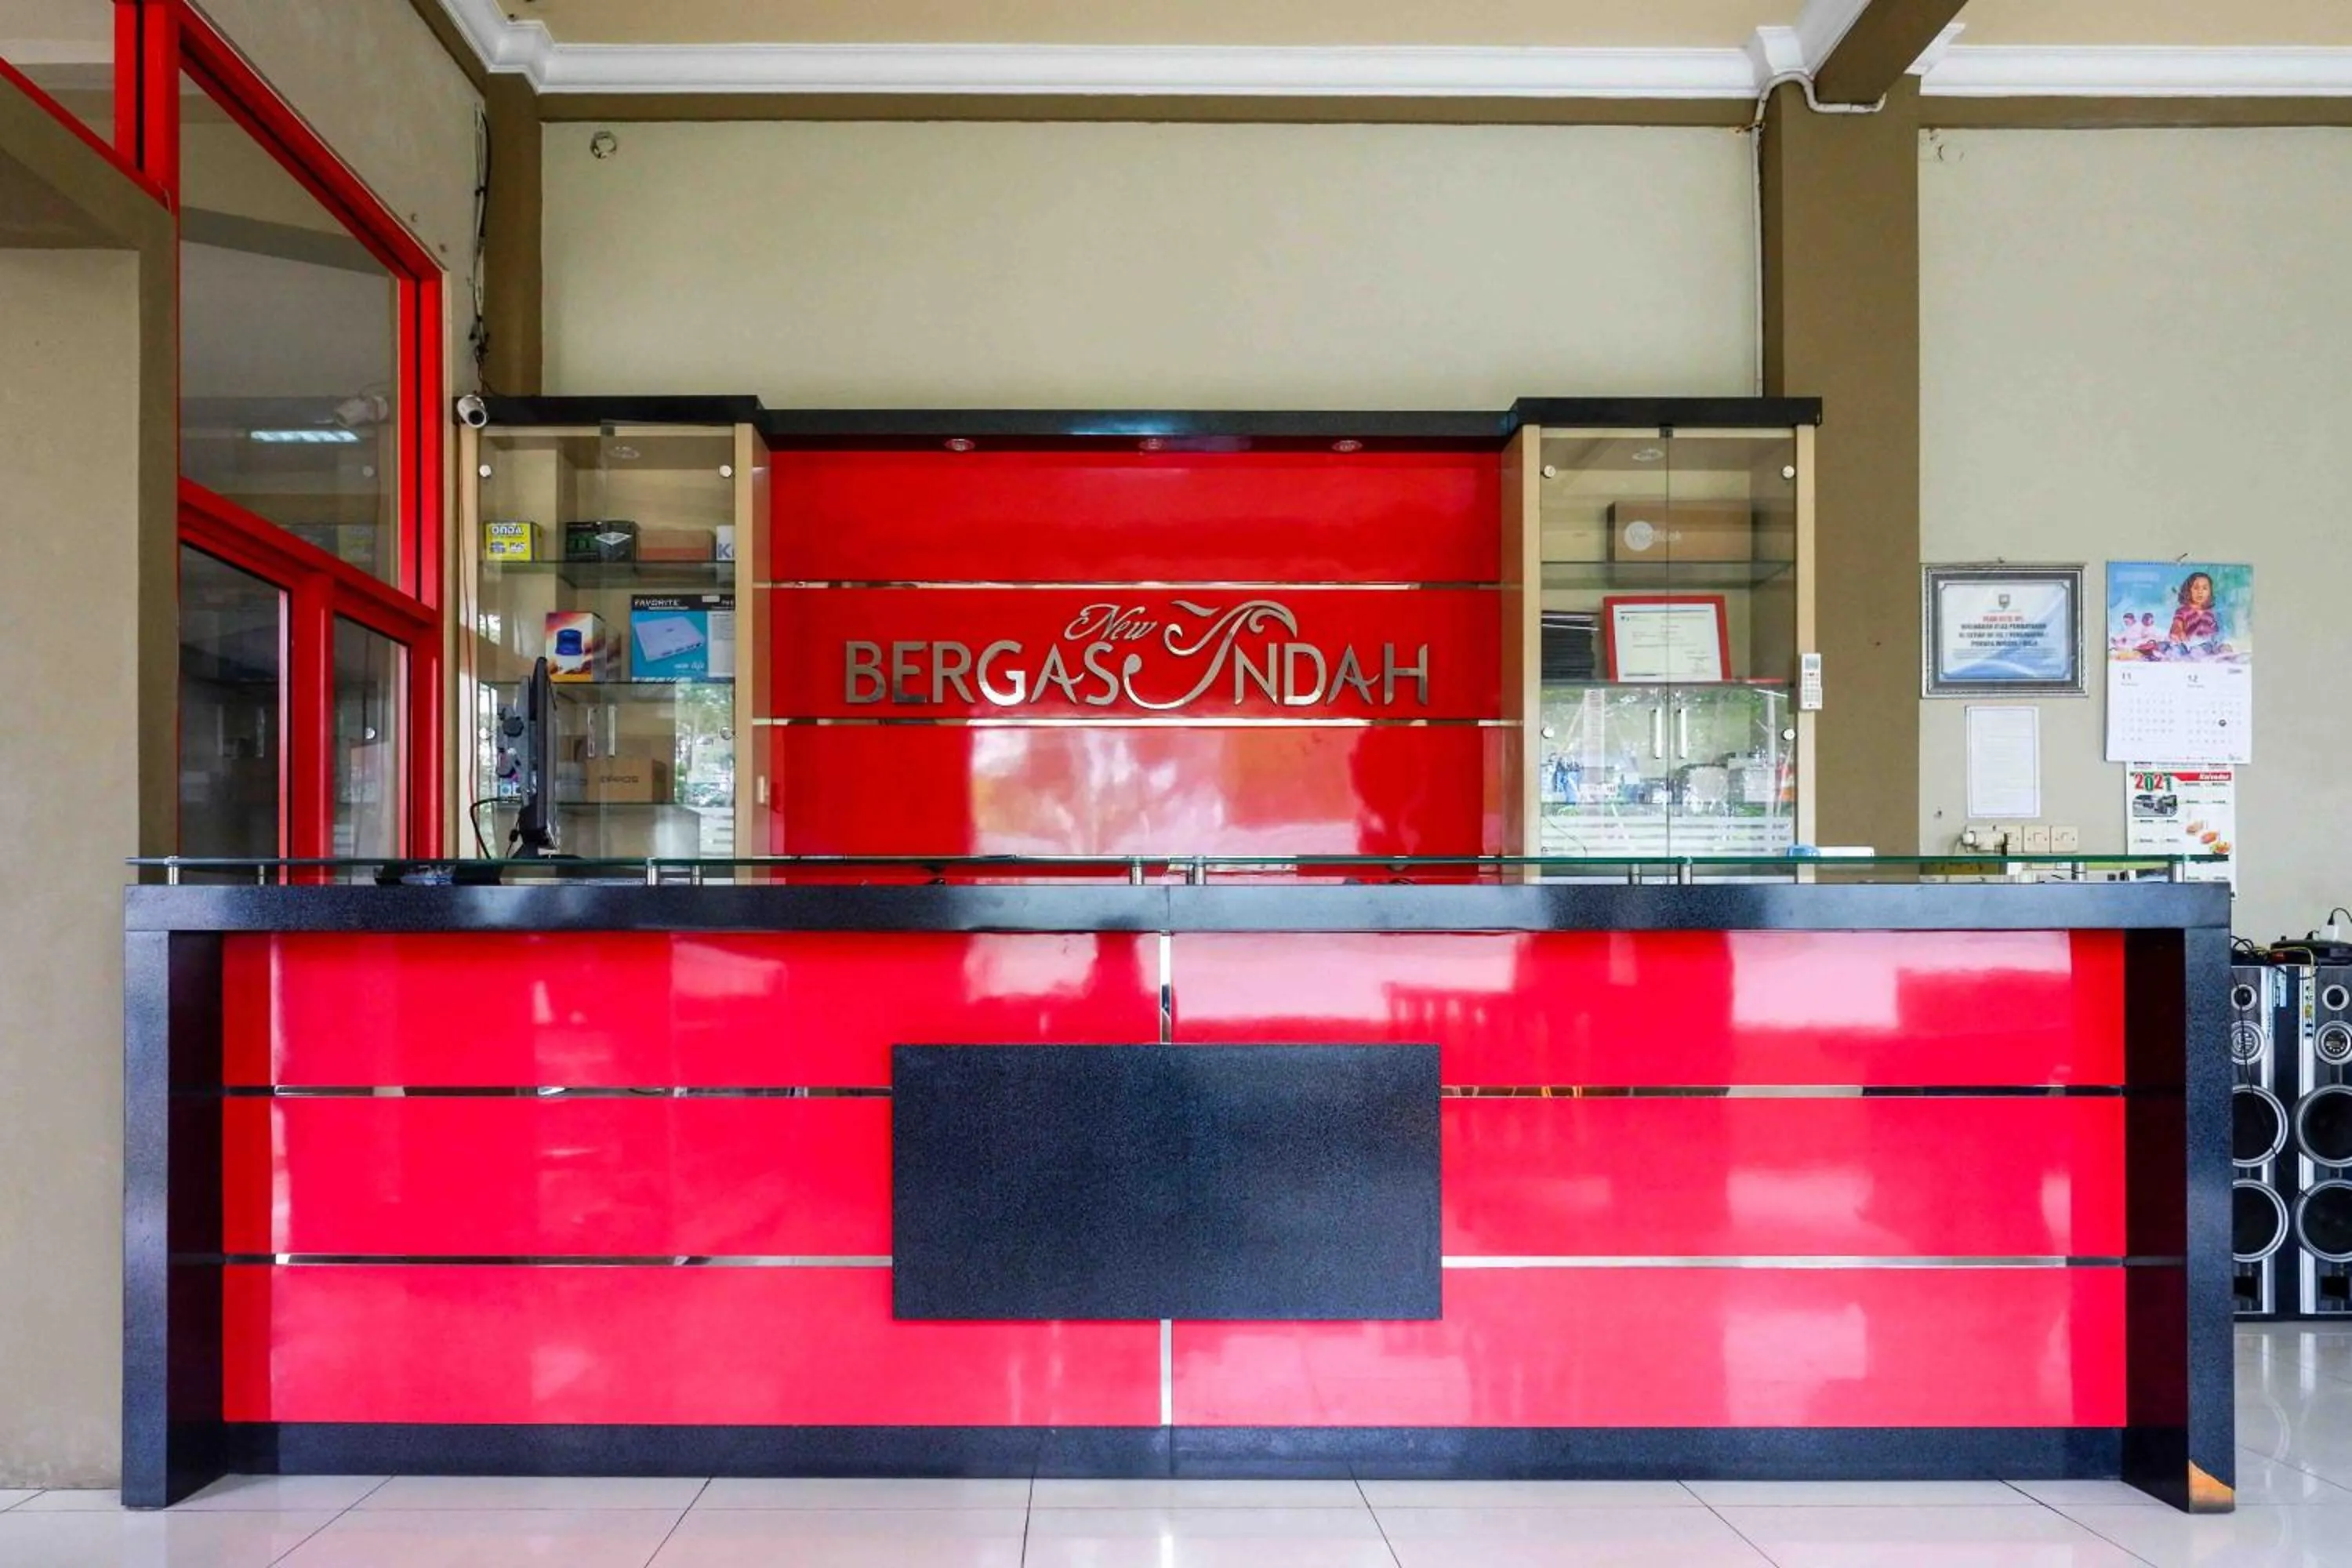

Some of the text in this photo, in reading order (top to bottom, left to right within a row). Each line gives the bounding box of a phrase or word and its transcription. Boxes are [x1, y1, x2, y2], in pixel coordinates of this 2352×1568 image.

[1064, 604, 1158, 641] New
[845, 600, 1428, 710] BERGAS INDAH
[2134, 772, 2172, 791] 2021
